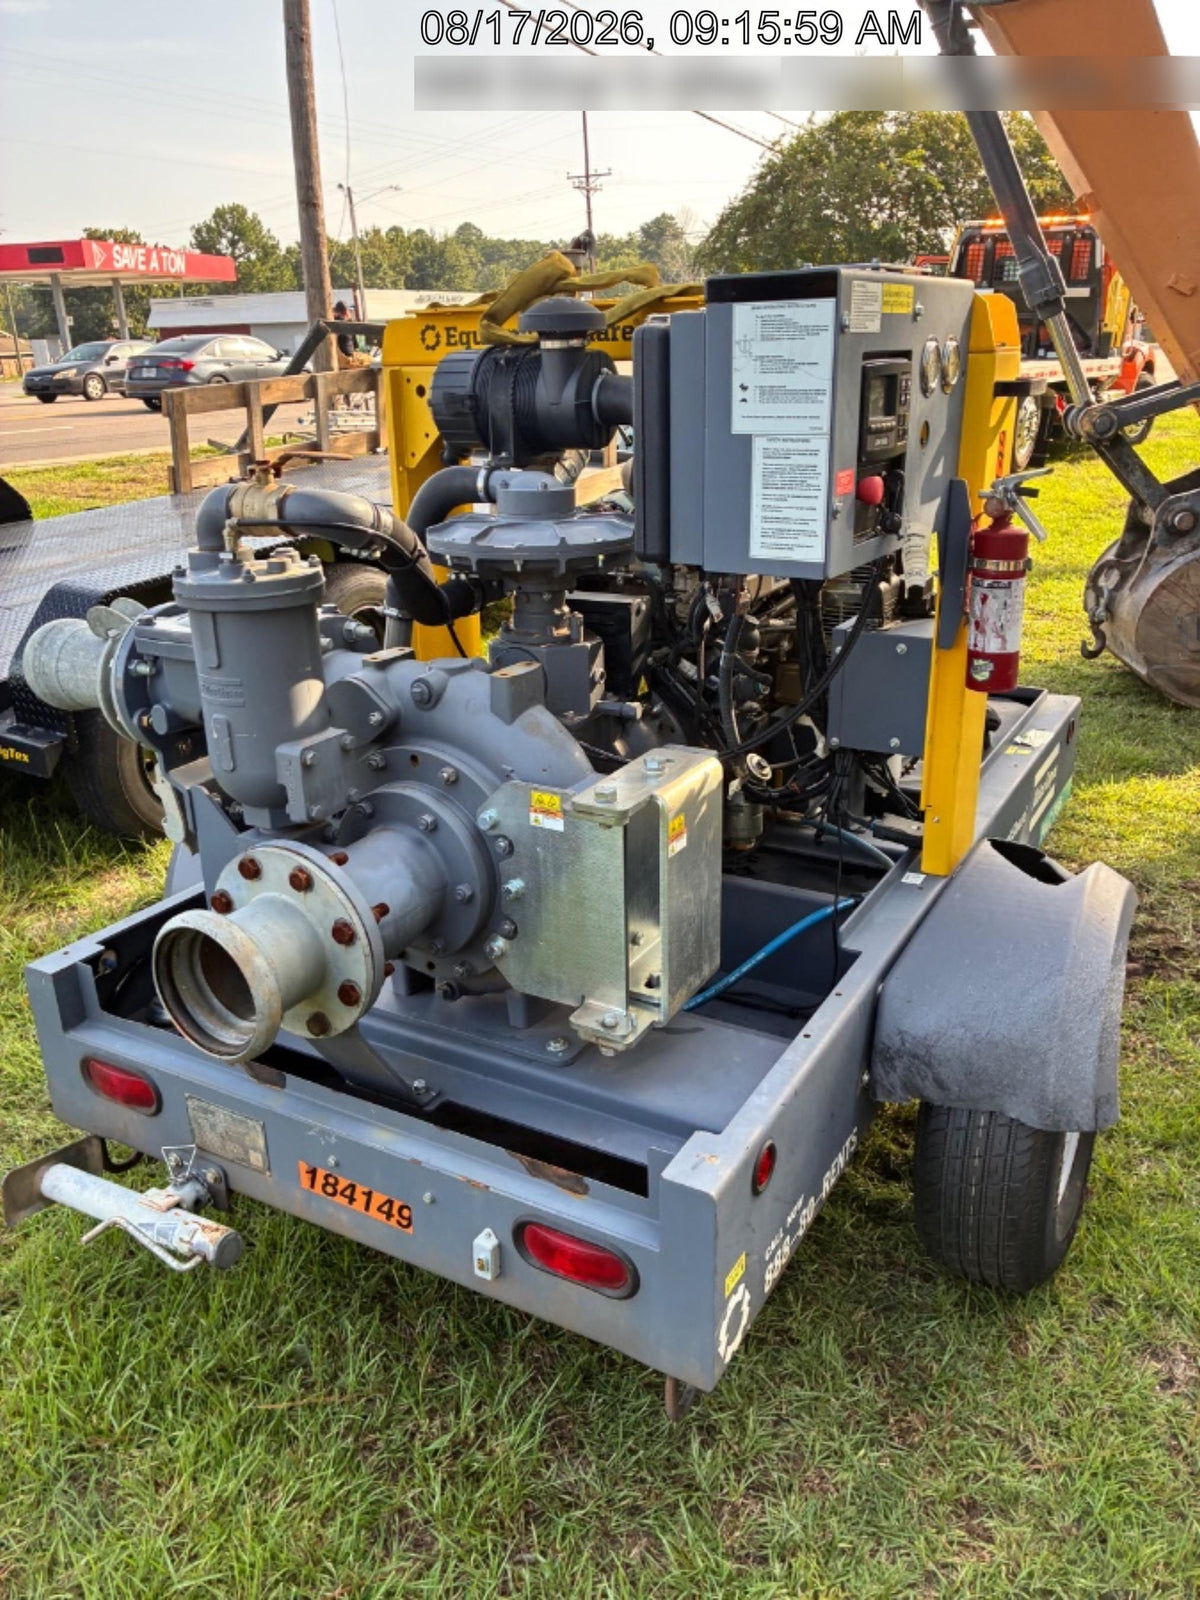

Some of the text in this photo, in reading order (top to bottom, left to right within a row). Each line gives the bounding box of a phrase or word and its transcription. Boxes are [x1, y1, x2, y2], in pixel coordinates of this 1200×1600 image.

[112, 244, 186, 274] SAVE A TON
[305, 1167, 414, 1230] 184149
